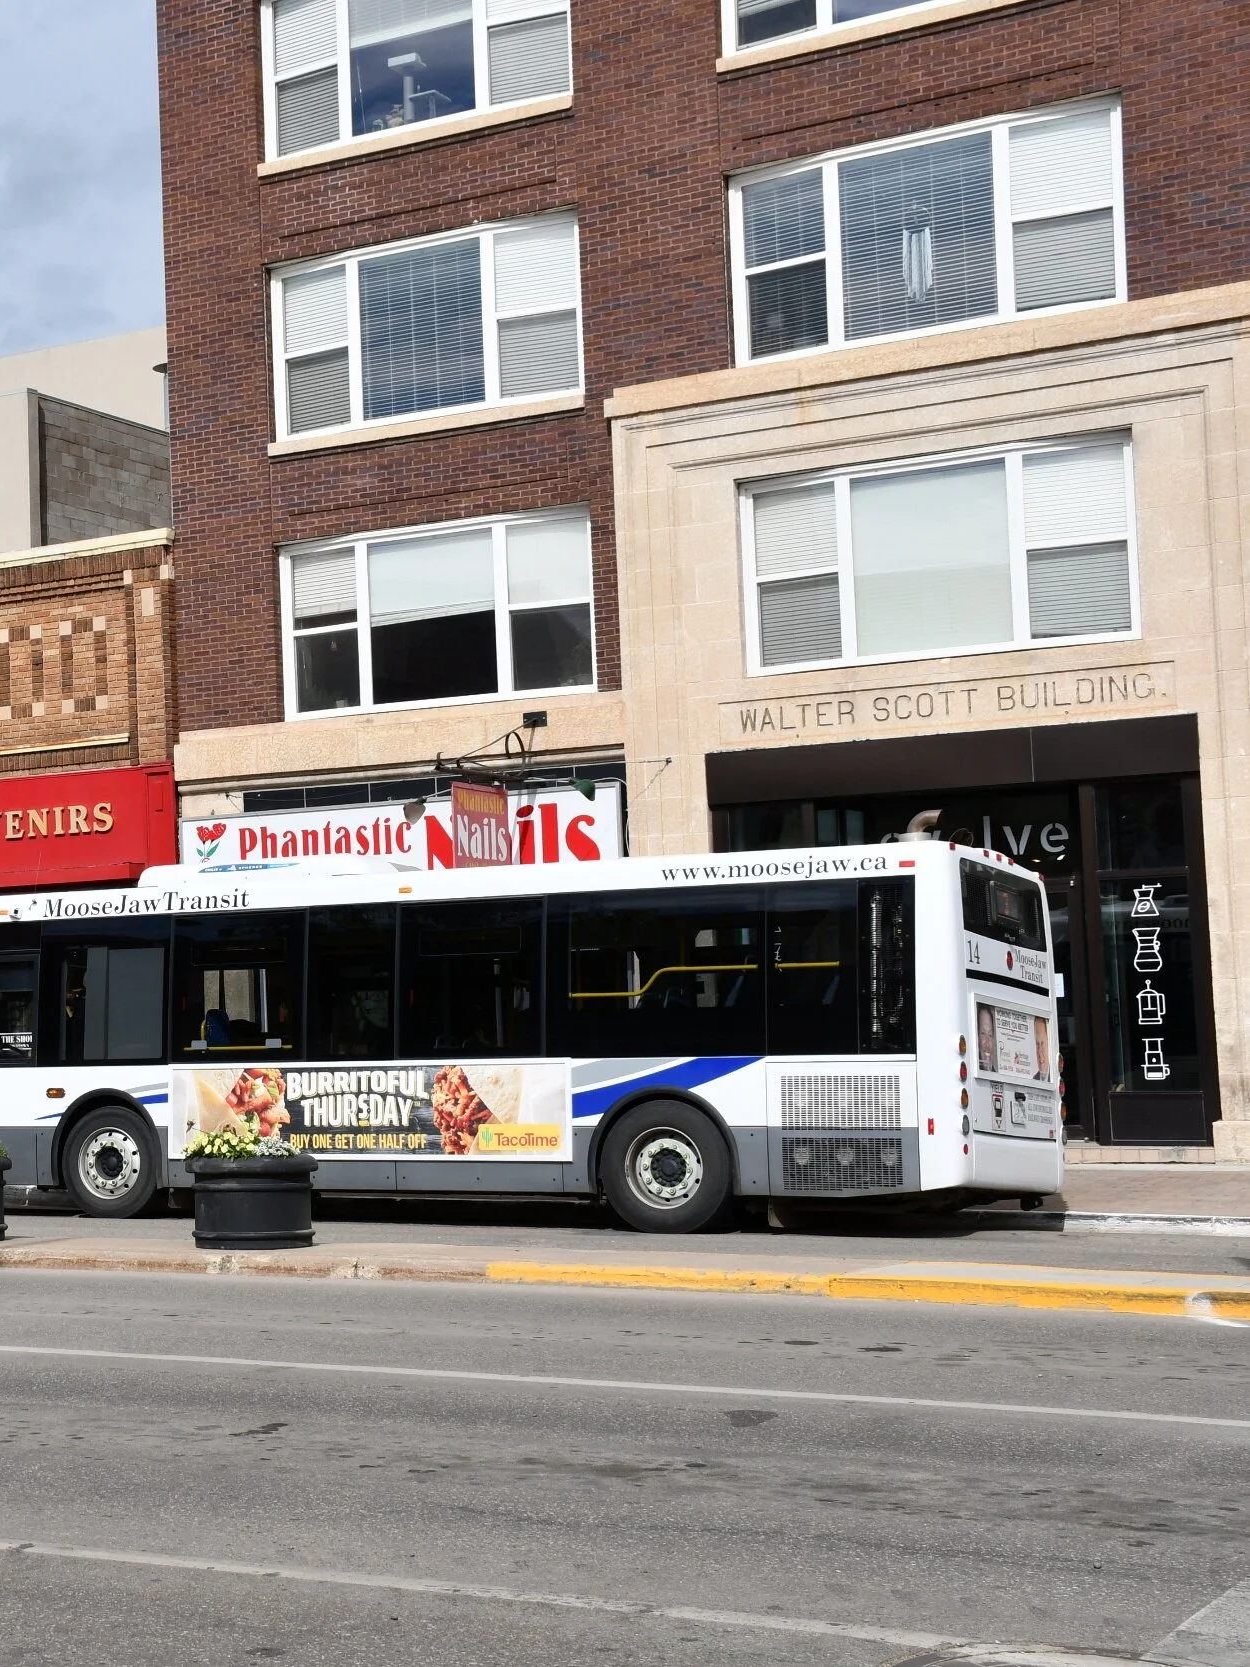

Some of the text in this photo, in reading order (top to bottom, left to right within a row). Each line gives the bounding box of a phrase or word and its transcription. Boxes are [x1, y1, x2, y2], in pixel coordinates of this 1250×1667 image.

[739, 699, 855, 735] WALTER
[872, 688, 978, 722] SCOTT
[458, 787, 505, 816] Phantastic
[238, 816, 412, 861] Phantastic
[456, 814, 508, 862] Nails
[662, 856, 889, 881] www.moosejaw.ca
[967, 940, 981, 964] 14
[1014, 948, 1047, 970] MooseJaw
[1019, 964, 1044, 984] Transit
[1, 1035, 15, 1044] THE
[286, 1070, 431, 1101] BURRITOFUL
[300, 1094, 413, 1128] THURSDAY
[290, 1133, 427, 1149] BUY ONE GET ONE HALF OFF
[493, 1132, 559, 1148] TacoTime
